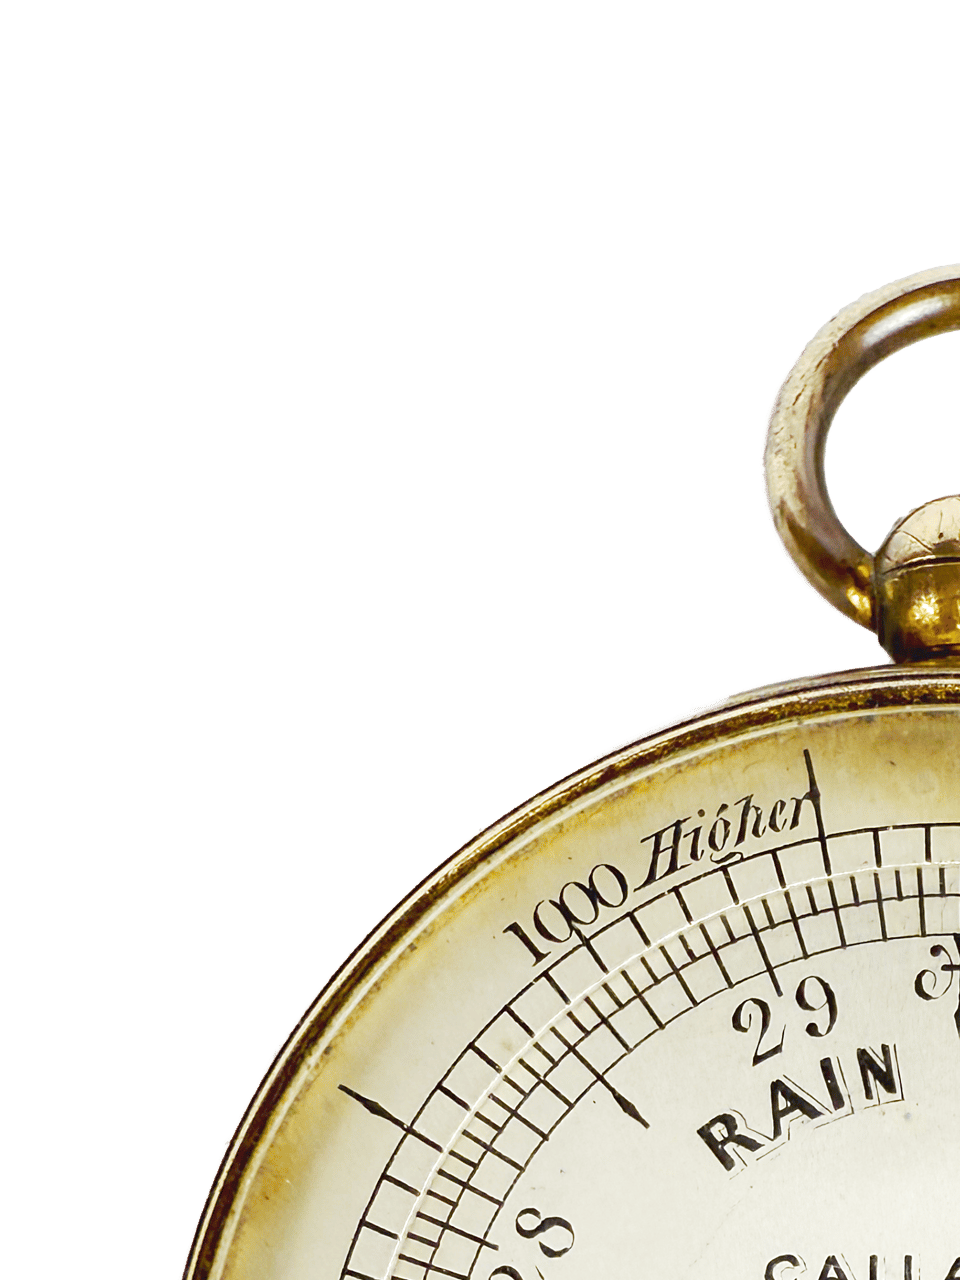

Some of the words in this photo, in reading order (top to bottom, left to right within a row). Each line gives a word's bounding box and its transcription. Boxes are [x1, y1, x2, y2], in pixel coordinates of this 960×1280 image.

[502, 864, 630, 967] 1000
[633, 789, 822, 893] Higher
[731, 975, 838, 1066] 29
[697, 1042, 899, 1180] RAIN
